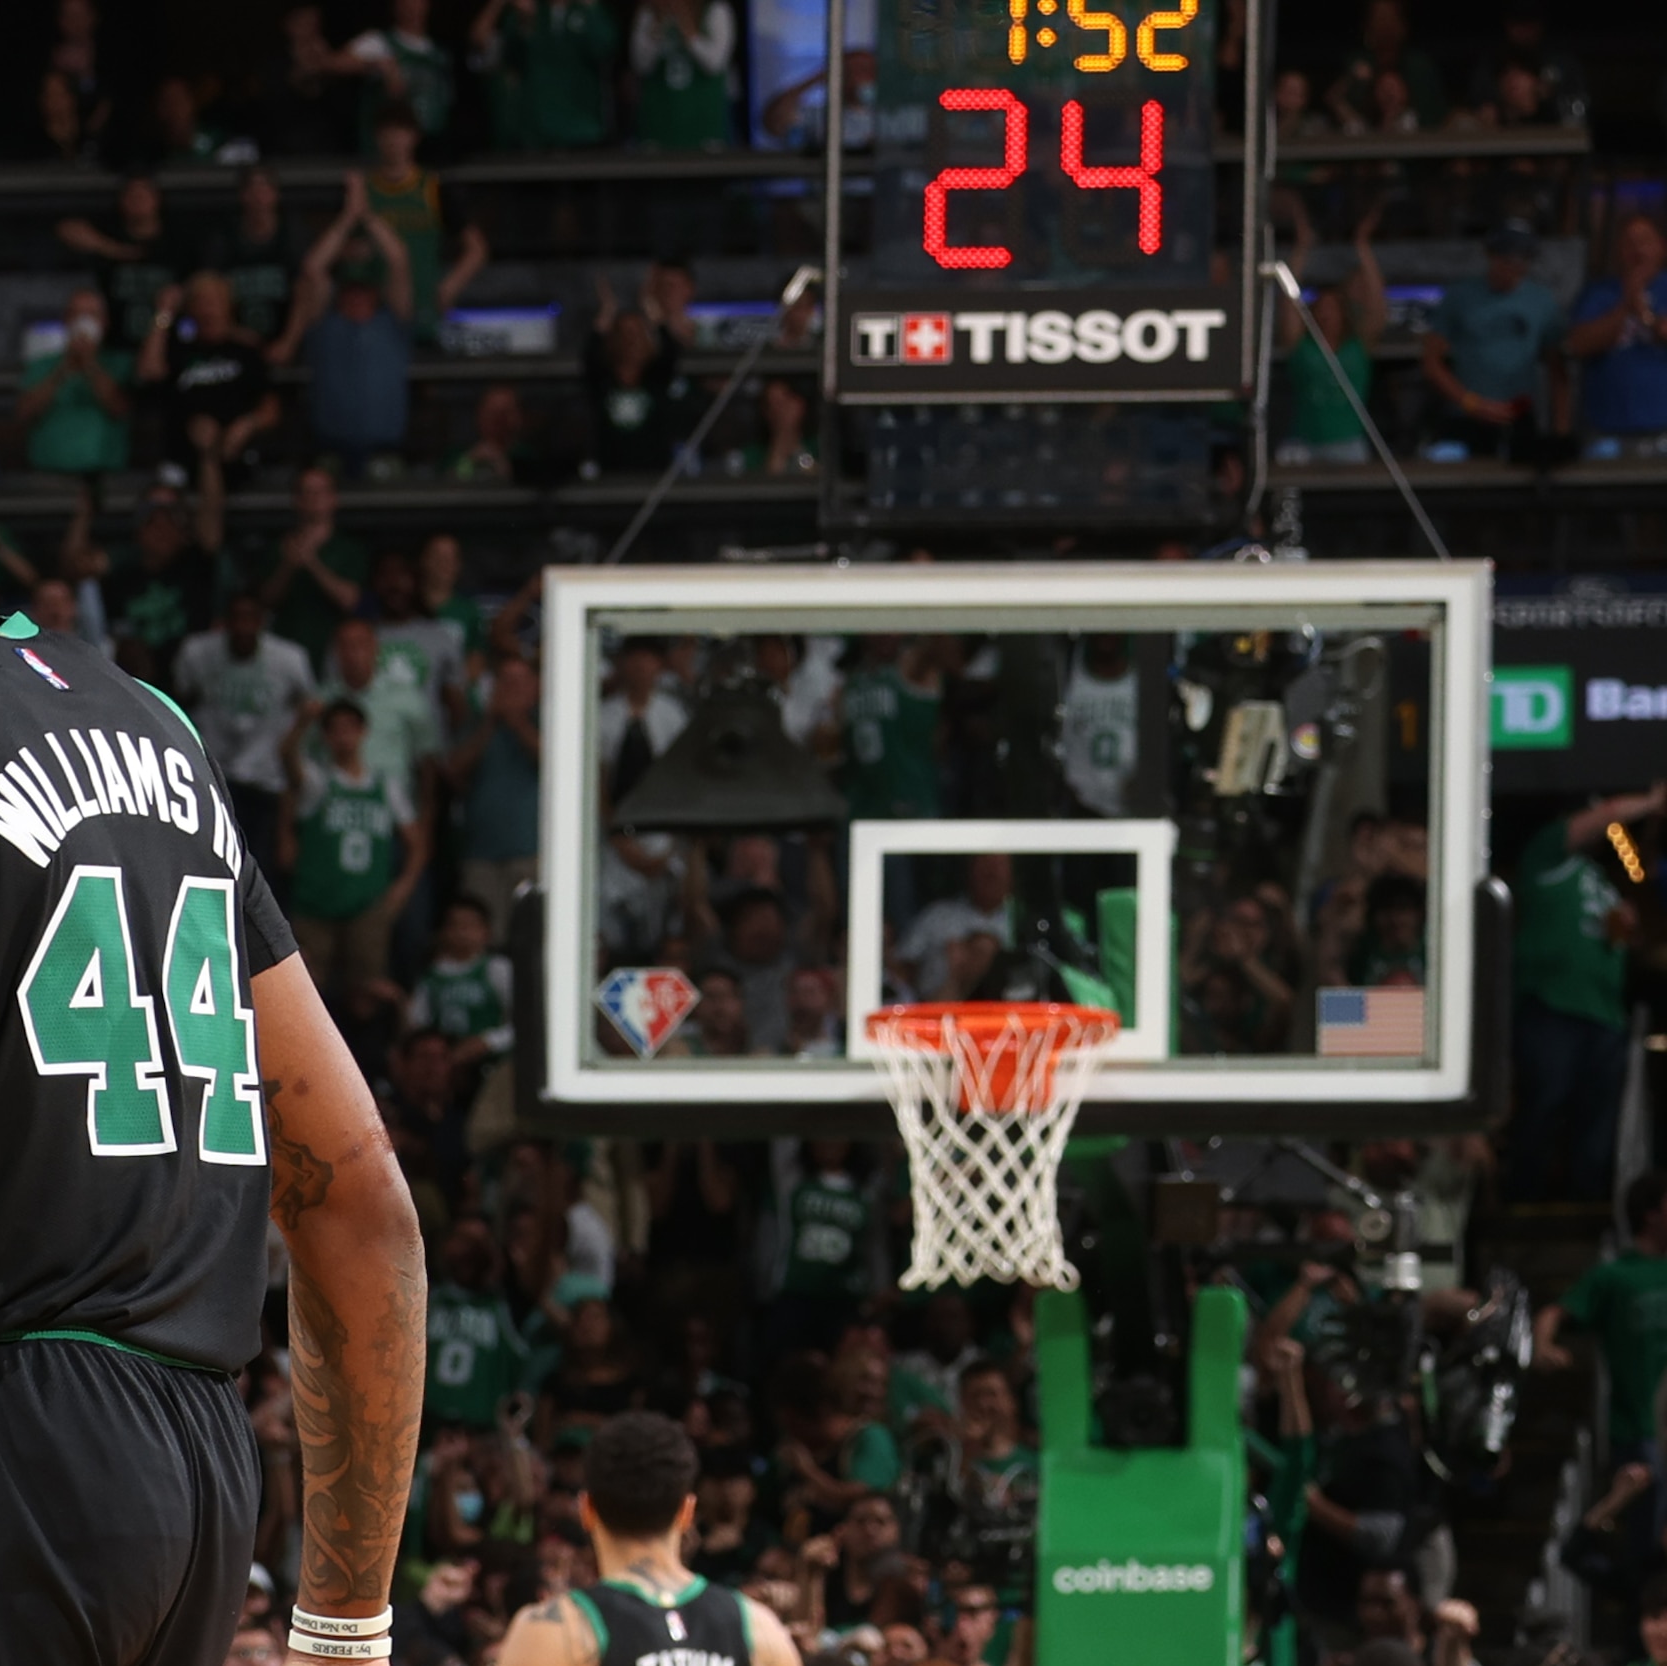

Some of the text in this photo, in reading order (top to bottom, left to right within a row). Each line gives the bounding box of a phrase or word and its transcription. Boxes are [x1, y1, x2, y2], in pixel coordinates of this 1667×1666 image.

[1008, 0, 1199, 73] 1:52
[923, 88, 1165, 269] 24
[954, 309, 1228, 363] TISSOT
[1585, 677, 1667, 721] Ban
[17, 864, 267, 1167] 44
[1051, 1556, 1216, 1595] coinbase
[319, 1620, 340, 1633] Not
[341, 1622, 359, 1634] Do
[311, 1642, 353, 1656] FERRIS
